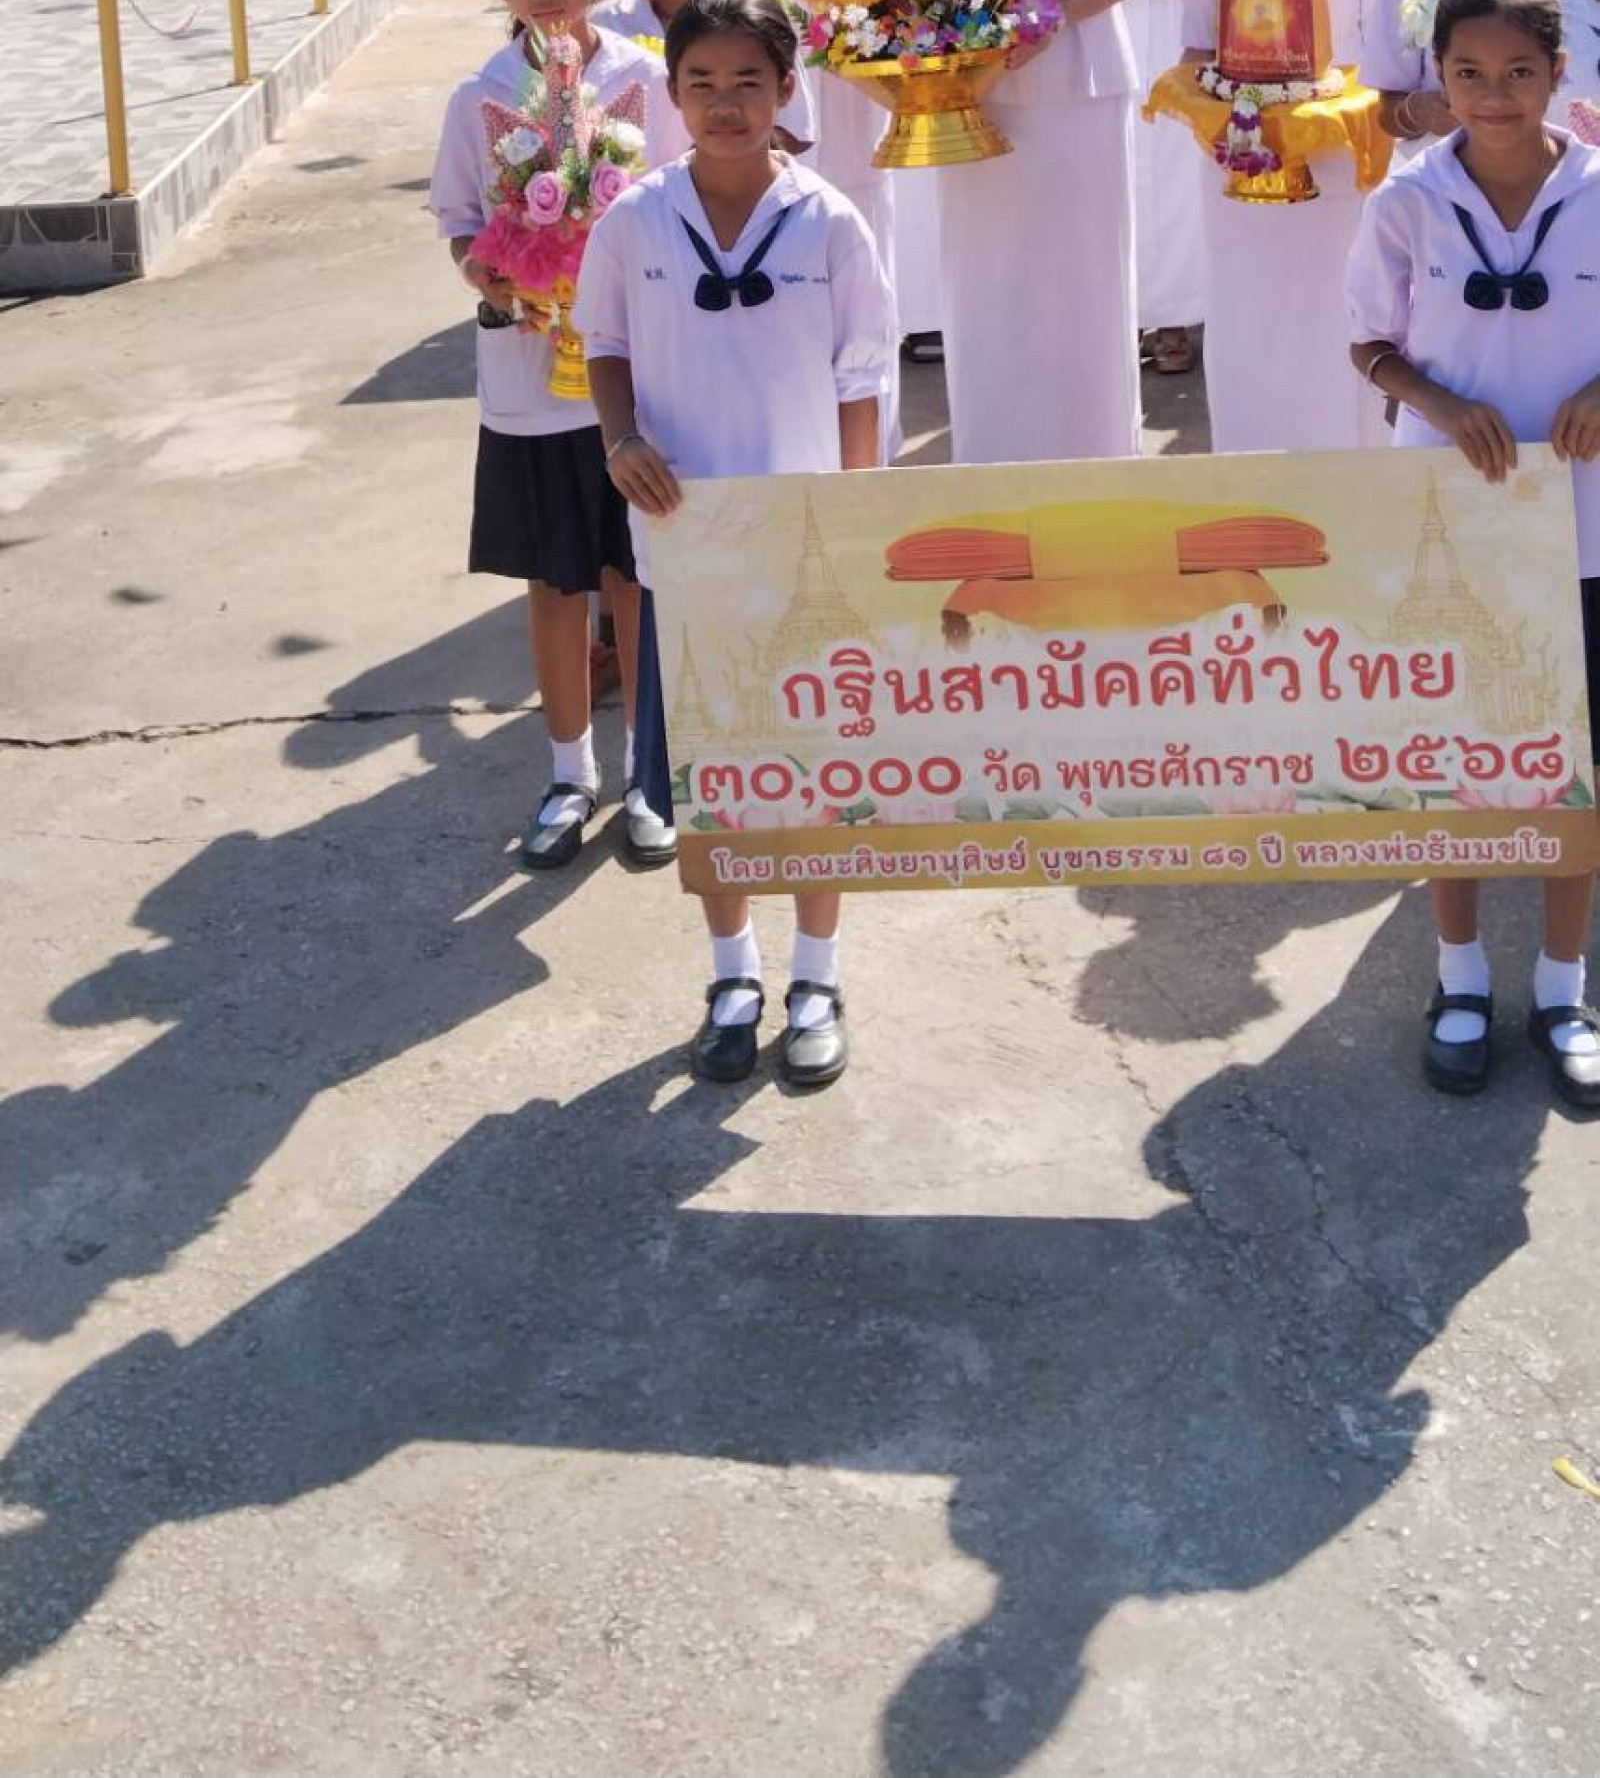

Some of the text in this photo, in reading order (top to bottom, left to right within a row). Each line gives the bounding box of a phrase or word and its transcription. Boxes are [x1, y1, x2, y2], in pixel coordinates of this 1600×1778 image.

[781, 613, 1456, 738] กฐินสามัคคีทั่วไทย
[697, 731, 1564, 809] ๓๐,๐๐๐ วัด พุทธศักราช ๒๕๖๘
[713, 851, 770, 879] โดย
[784, 840, 1028, 882] คณะศิษยานุศิษย์
[1203, 843, 1248, 866] ๘๑
[1260, 834, 1282, 865] ปี
[1297, 828, 1560, 865] หลวงพ่อธัมมชโย
